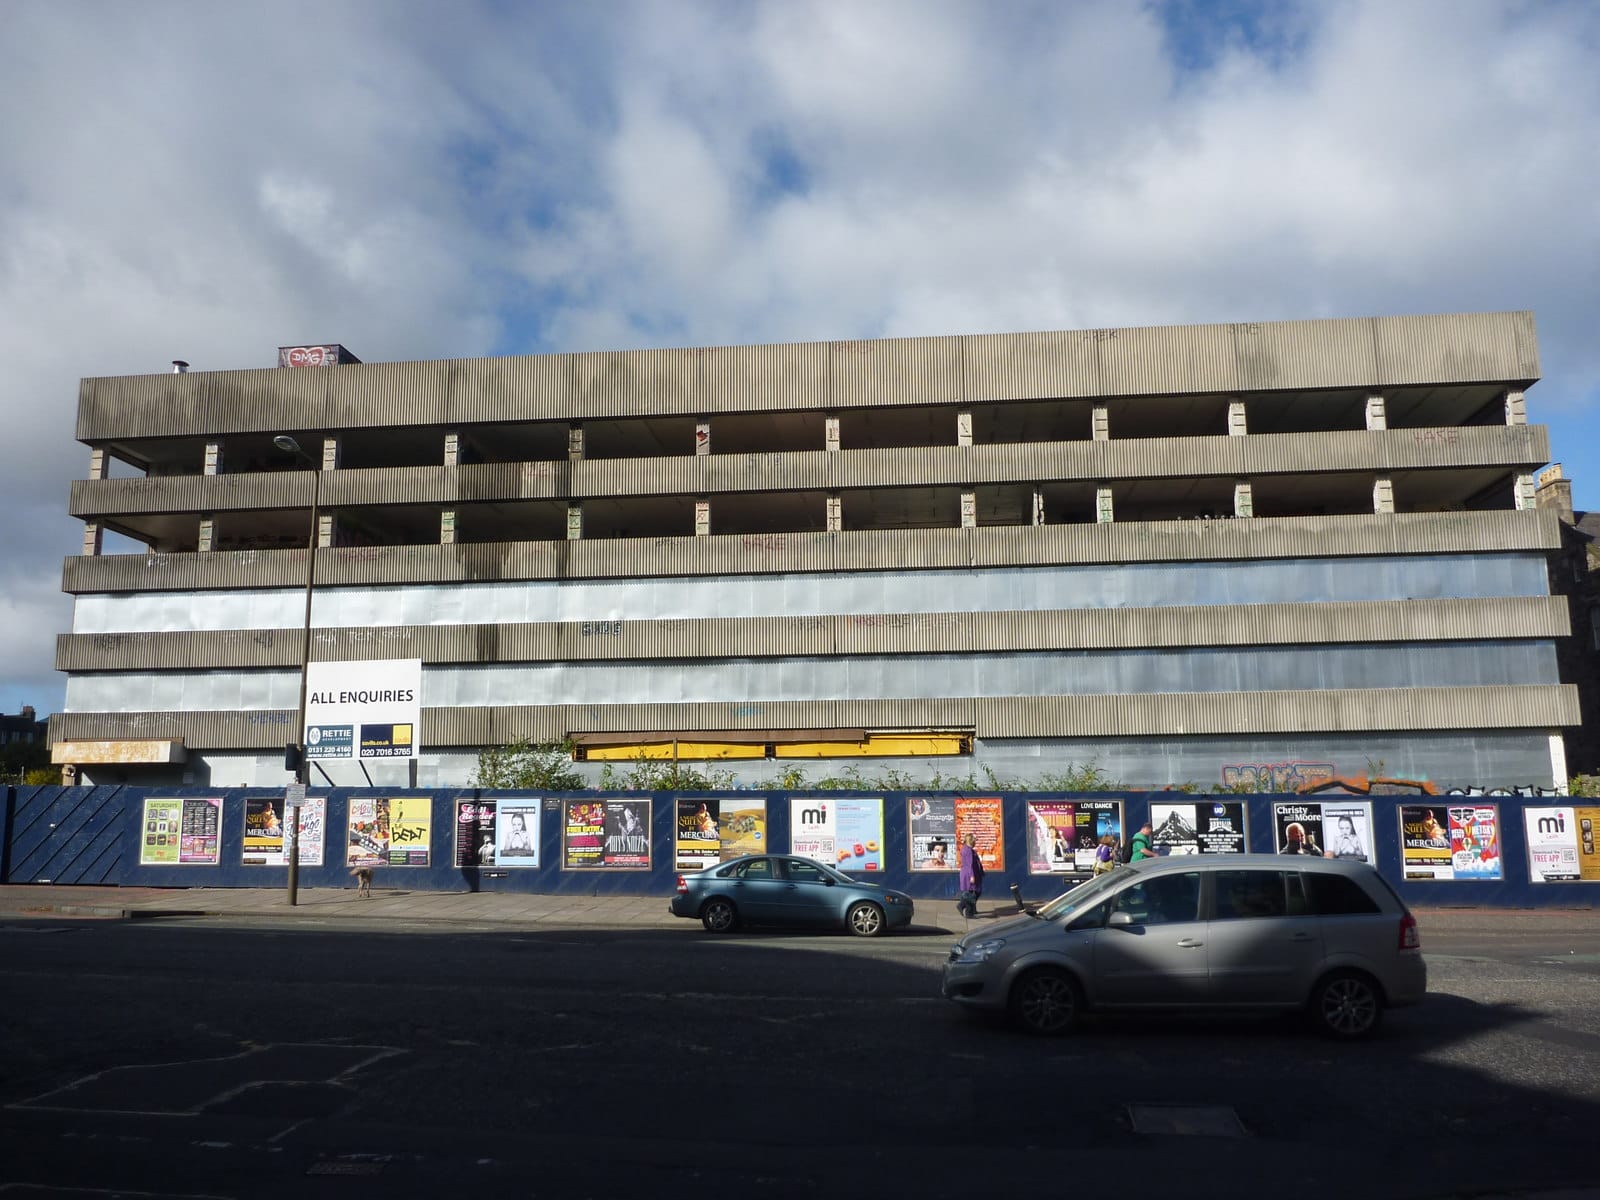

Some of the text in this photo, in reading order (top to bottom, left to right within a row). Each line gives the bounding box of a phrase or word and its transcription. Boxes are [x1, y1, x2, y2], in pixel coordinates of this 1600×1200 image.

[310, 690, 414, 704] ALL ENQUIRIES
[322, 729, 352, 737] RETTIE
[1276, 806, 1308, 815] Christy
[246, 828, 283, 836] MERCURY
[680, 831, 718, 839] MERCURY
[1406, 839, 1449, 847] MERCURY
[1534, 854, 1560, 863] FREE APP
